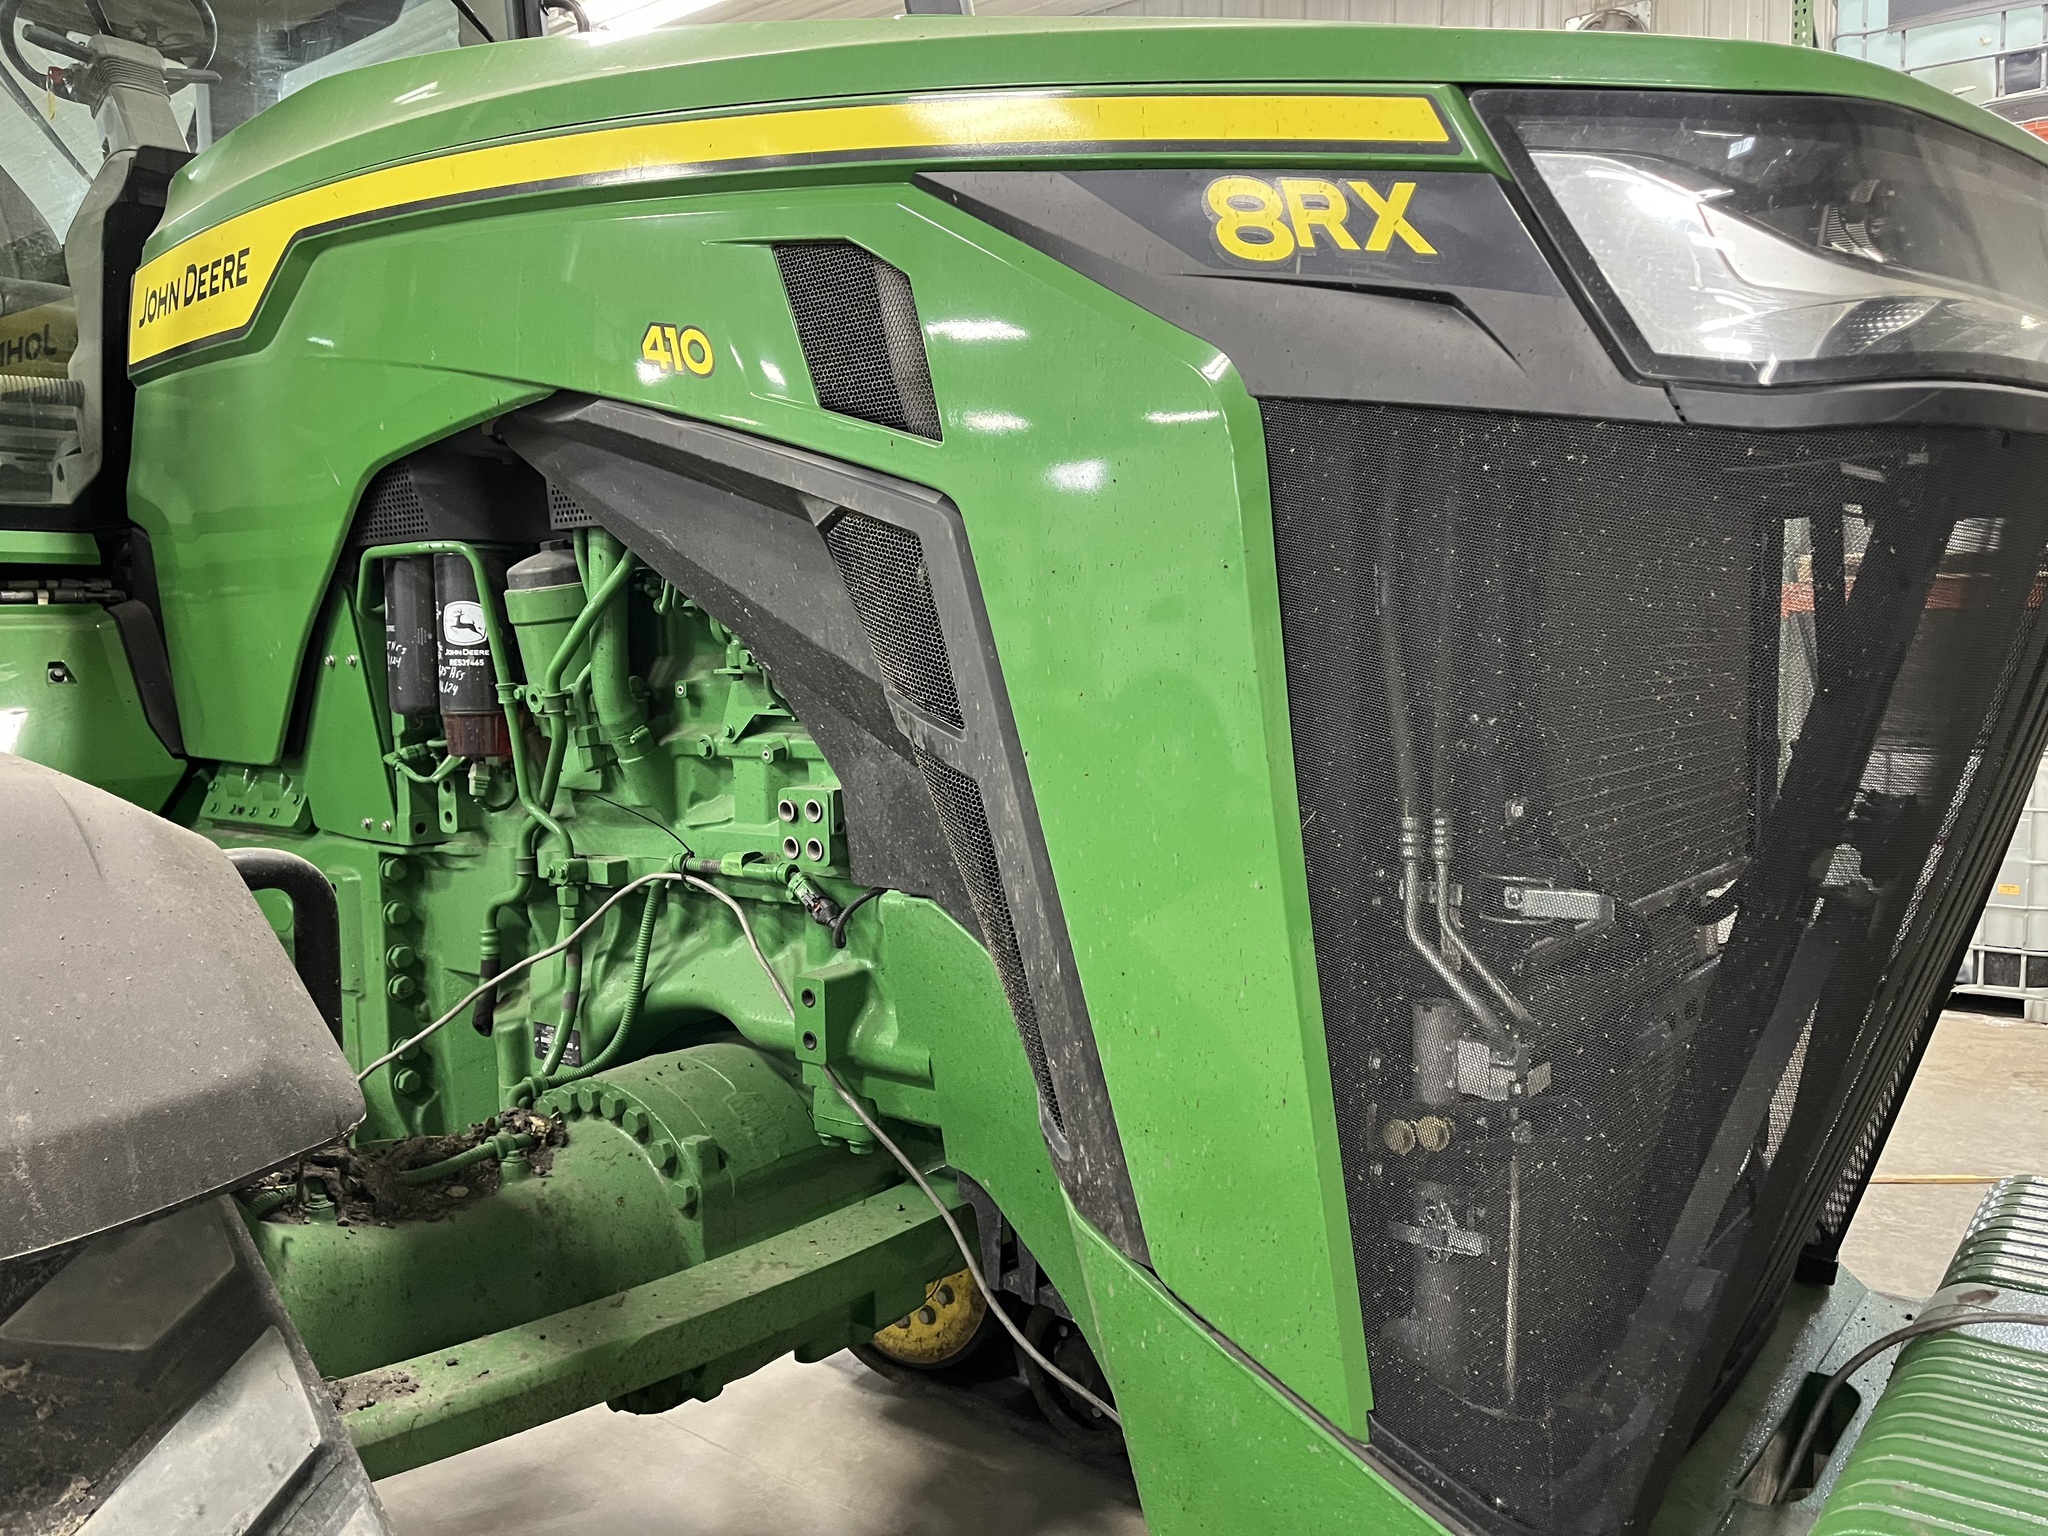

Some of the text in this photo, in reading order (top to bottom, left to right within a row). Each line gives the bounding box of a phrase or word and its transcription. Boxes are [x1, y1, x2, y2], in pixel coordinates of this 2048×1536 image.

[1204, 175, 1439, 264] 8RX
[138, 247, 250, 329] JOHN DEERE
[641, 322, 715, 379] 410
[462, 648, 490, 656] DEERE
